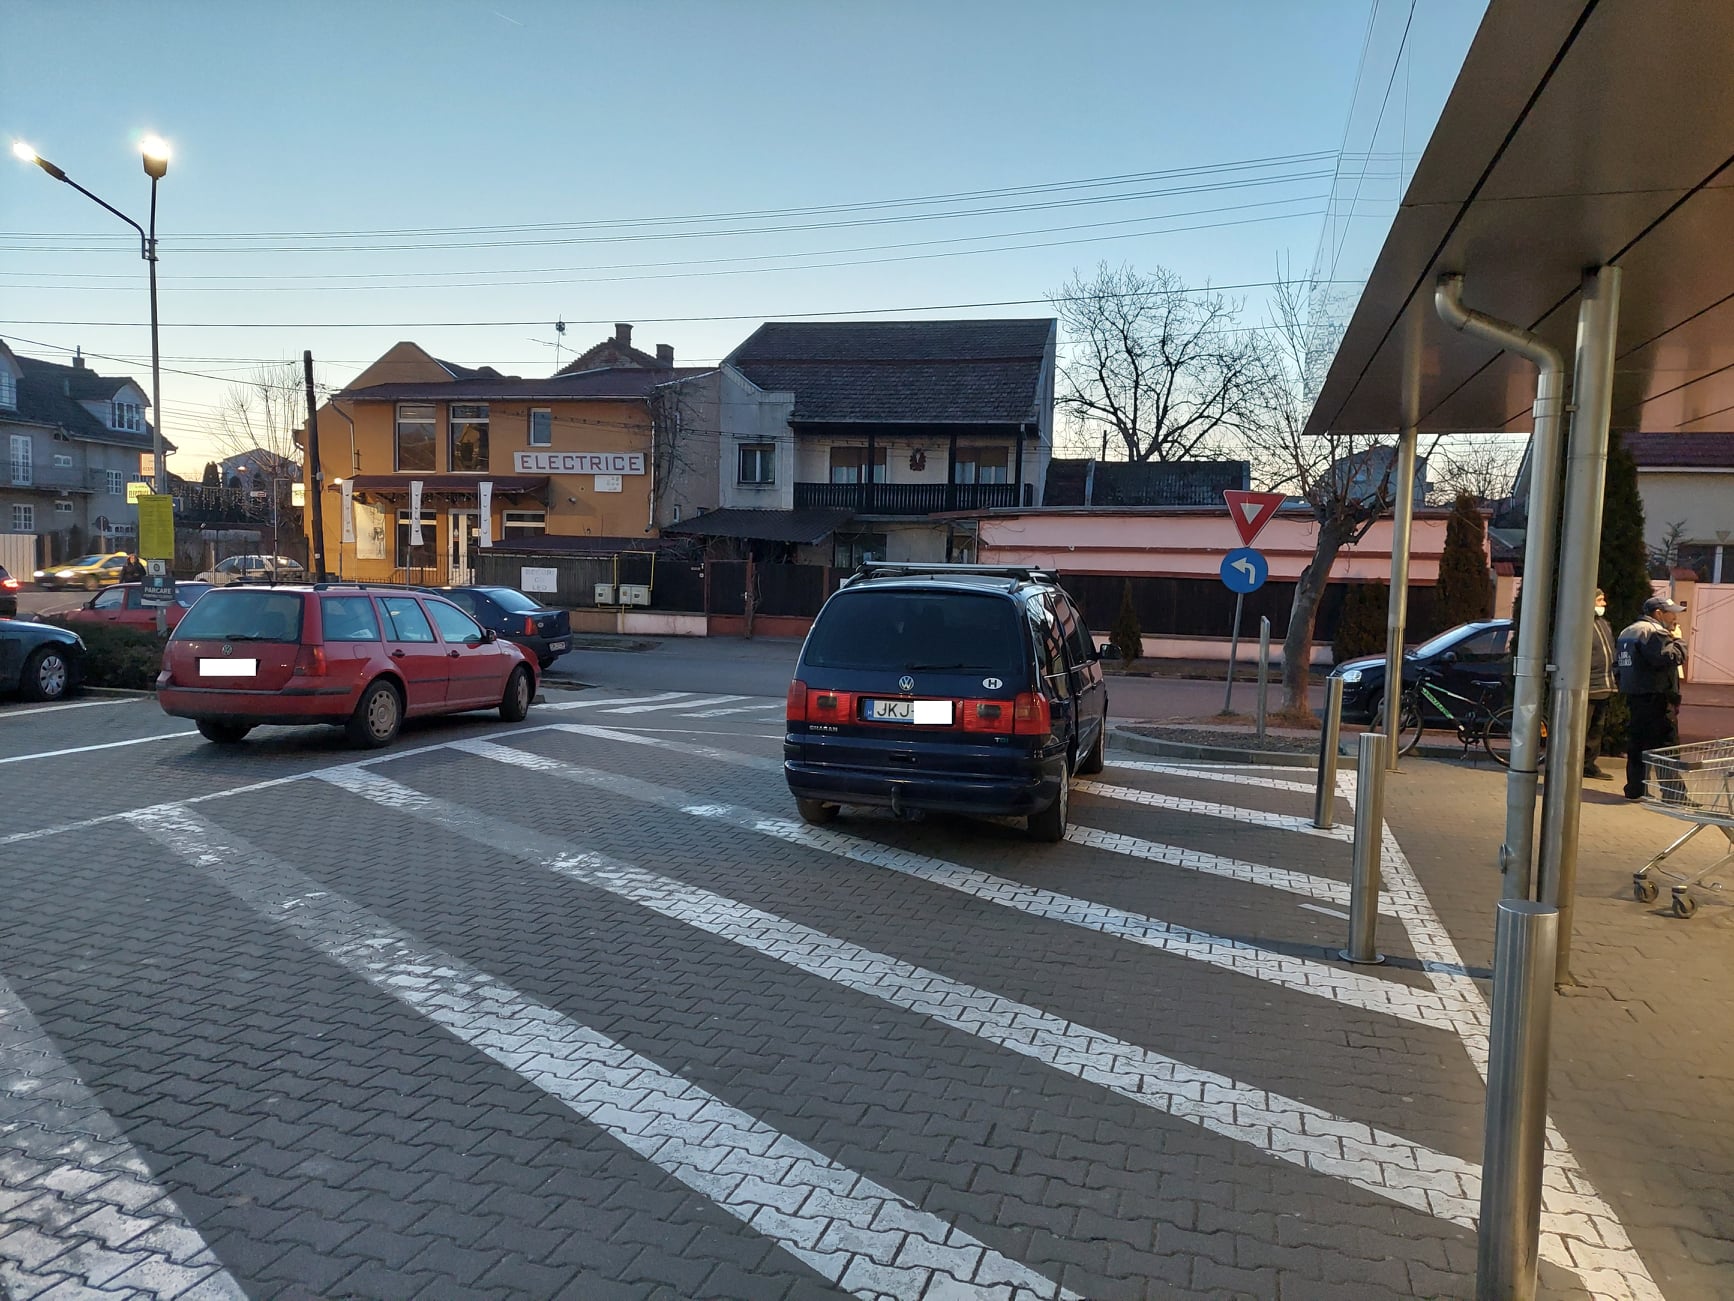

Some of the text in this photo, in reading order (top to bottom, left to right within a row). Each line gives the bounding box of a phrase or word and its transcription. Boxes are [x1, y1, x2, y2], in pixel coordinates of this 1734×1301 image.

[520, 454, 641, 471] ELECTRICE
[144, 586, 172, 594] PARCARE
[988, 679, 998, 688] H
